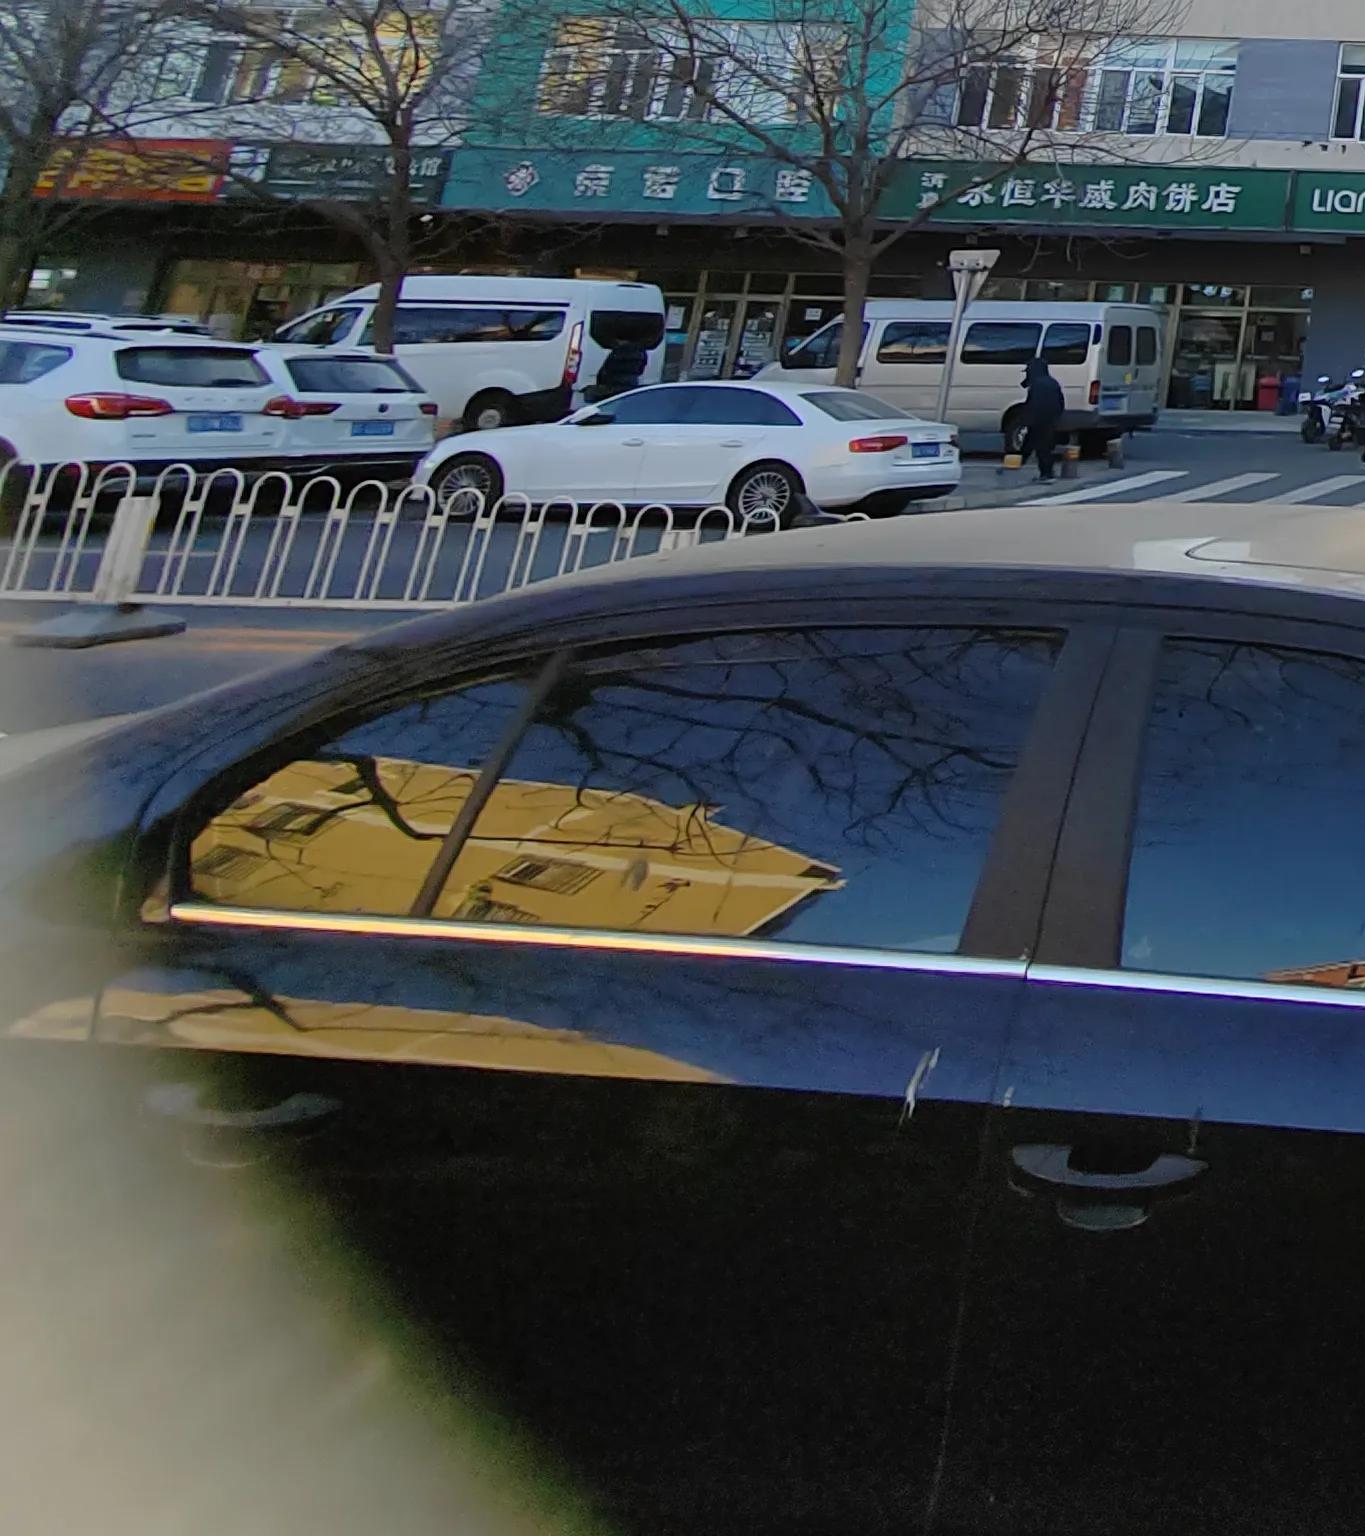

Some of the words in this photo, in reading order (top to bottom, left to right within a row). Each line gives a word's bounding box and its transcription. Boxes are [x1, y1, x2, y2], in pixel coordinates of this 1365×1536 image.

[956, 176, 1243, 214] 永恒华威肉饼店
